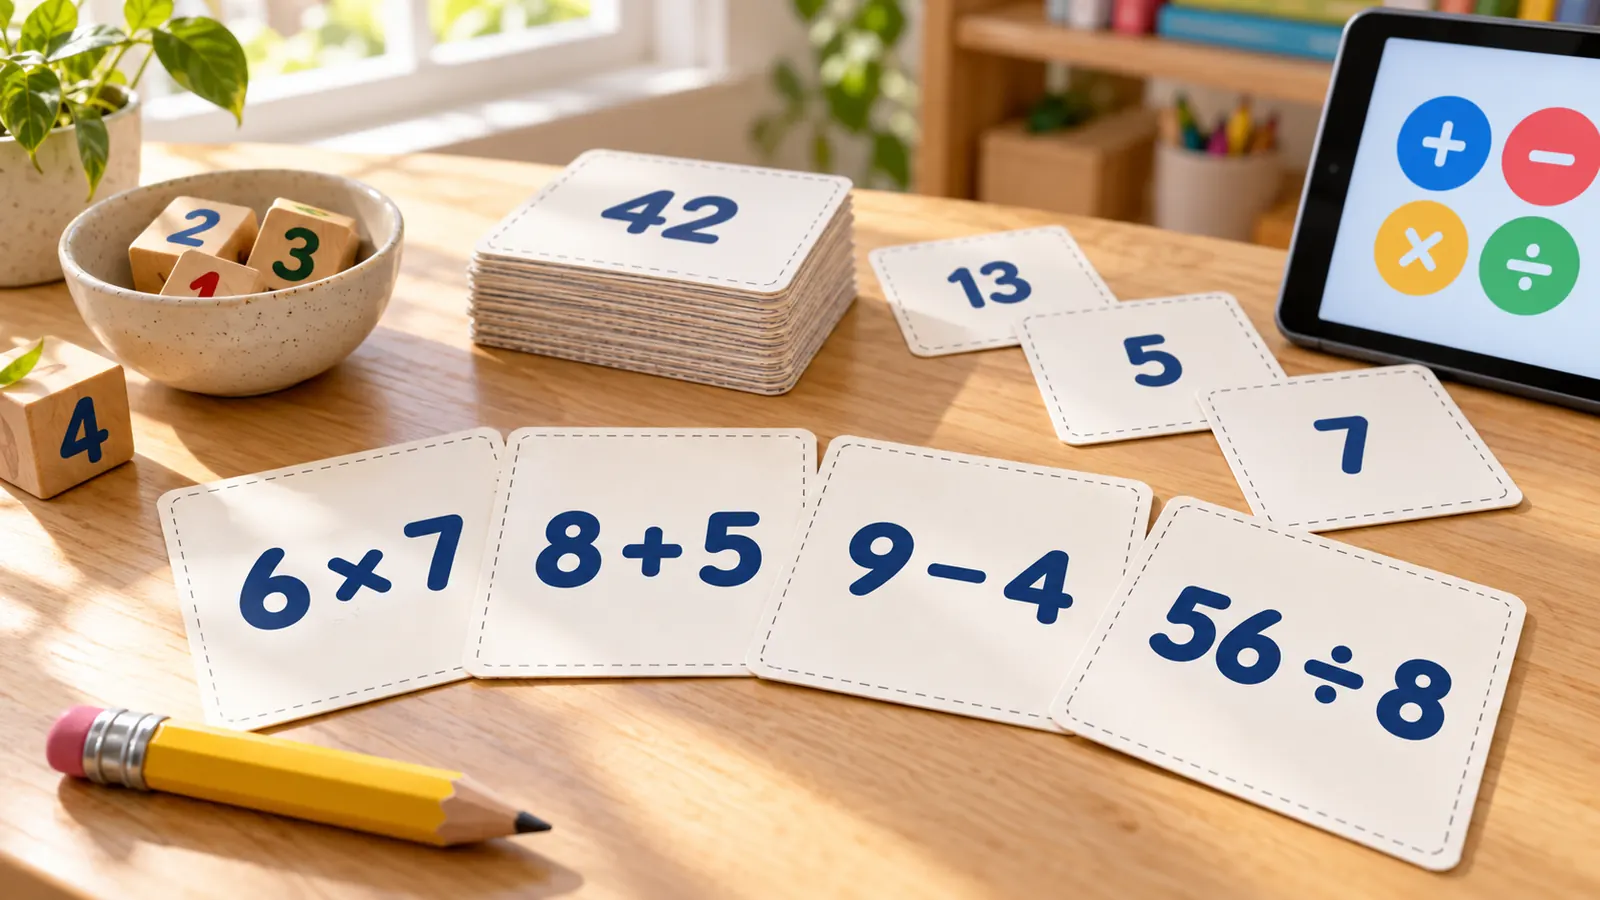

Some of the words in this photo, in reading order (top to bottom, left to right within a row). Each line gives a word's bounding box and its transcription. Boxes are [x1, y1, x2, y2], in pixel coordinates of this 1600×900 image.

[167, 208, 220, 247] 2
[602, 190, 738, 244] 42
[272, 227, 319, 281] 3
[947, 261, 1032, 309] 13
[1123, 334, 1183, 387] 5
[60, 396, 109, 463] 4
[1313, 415, 1369, 475] 7
